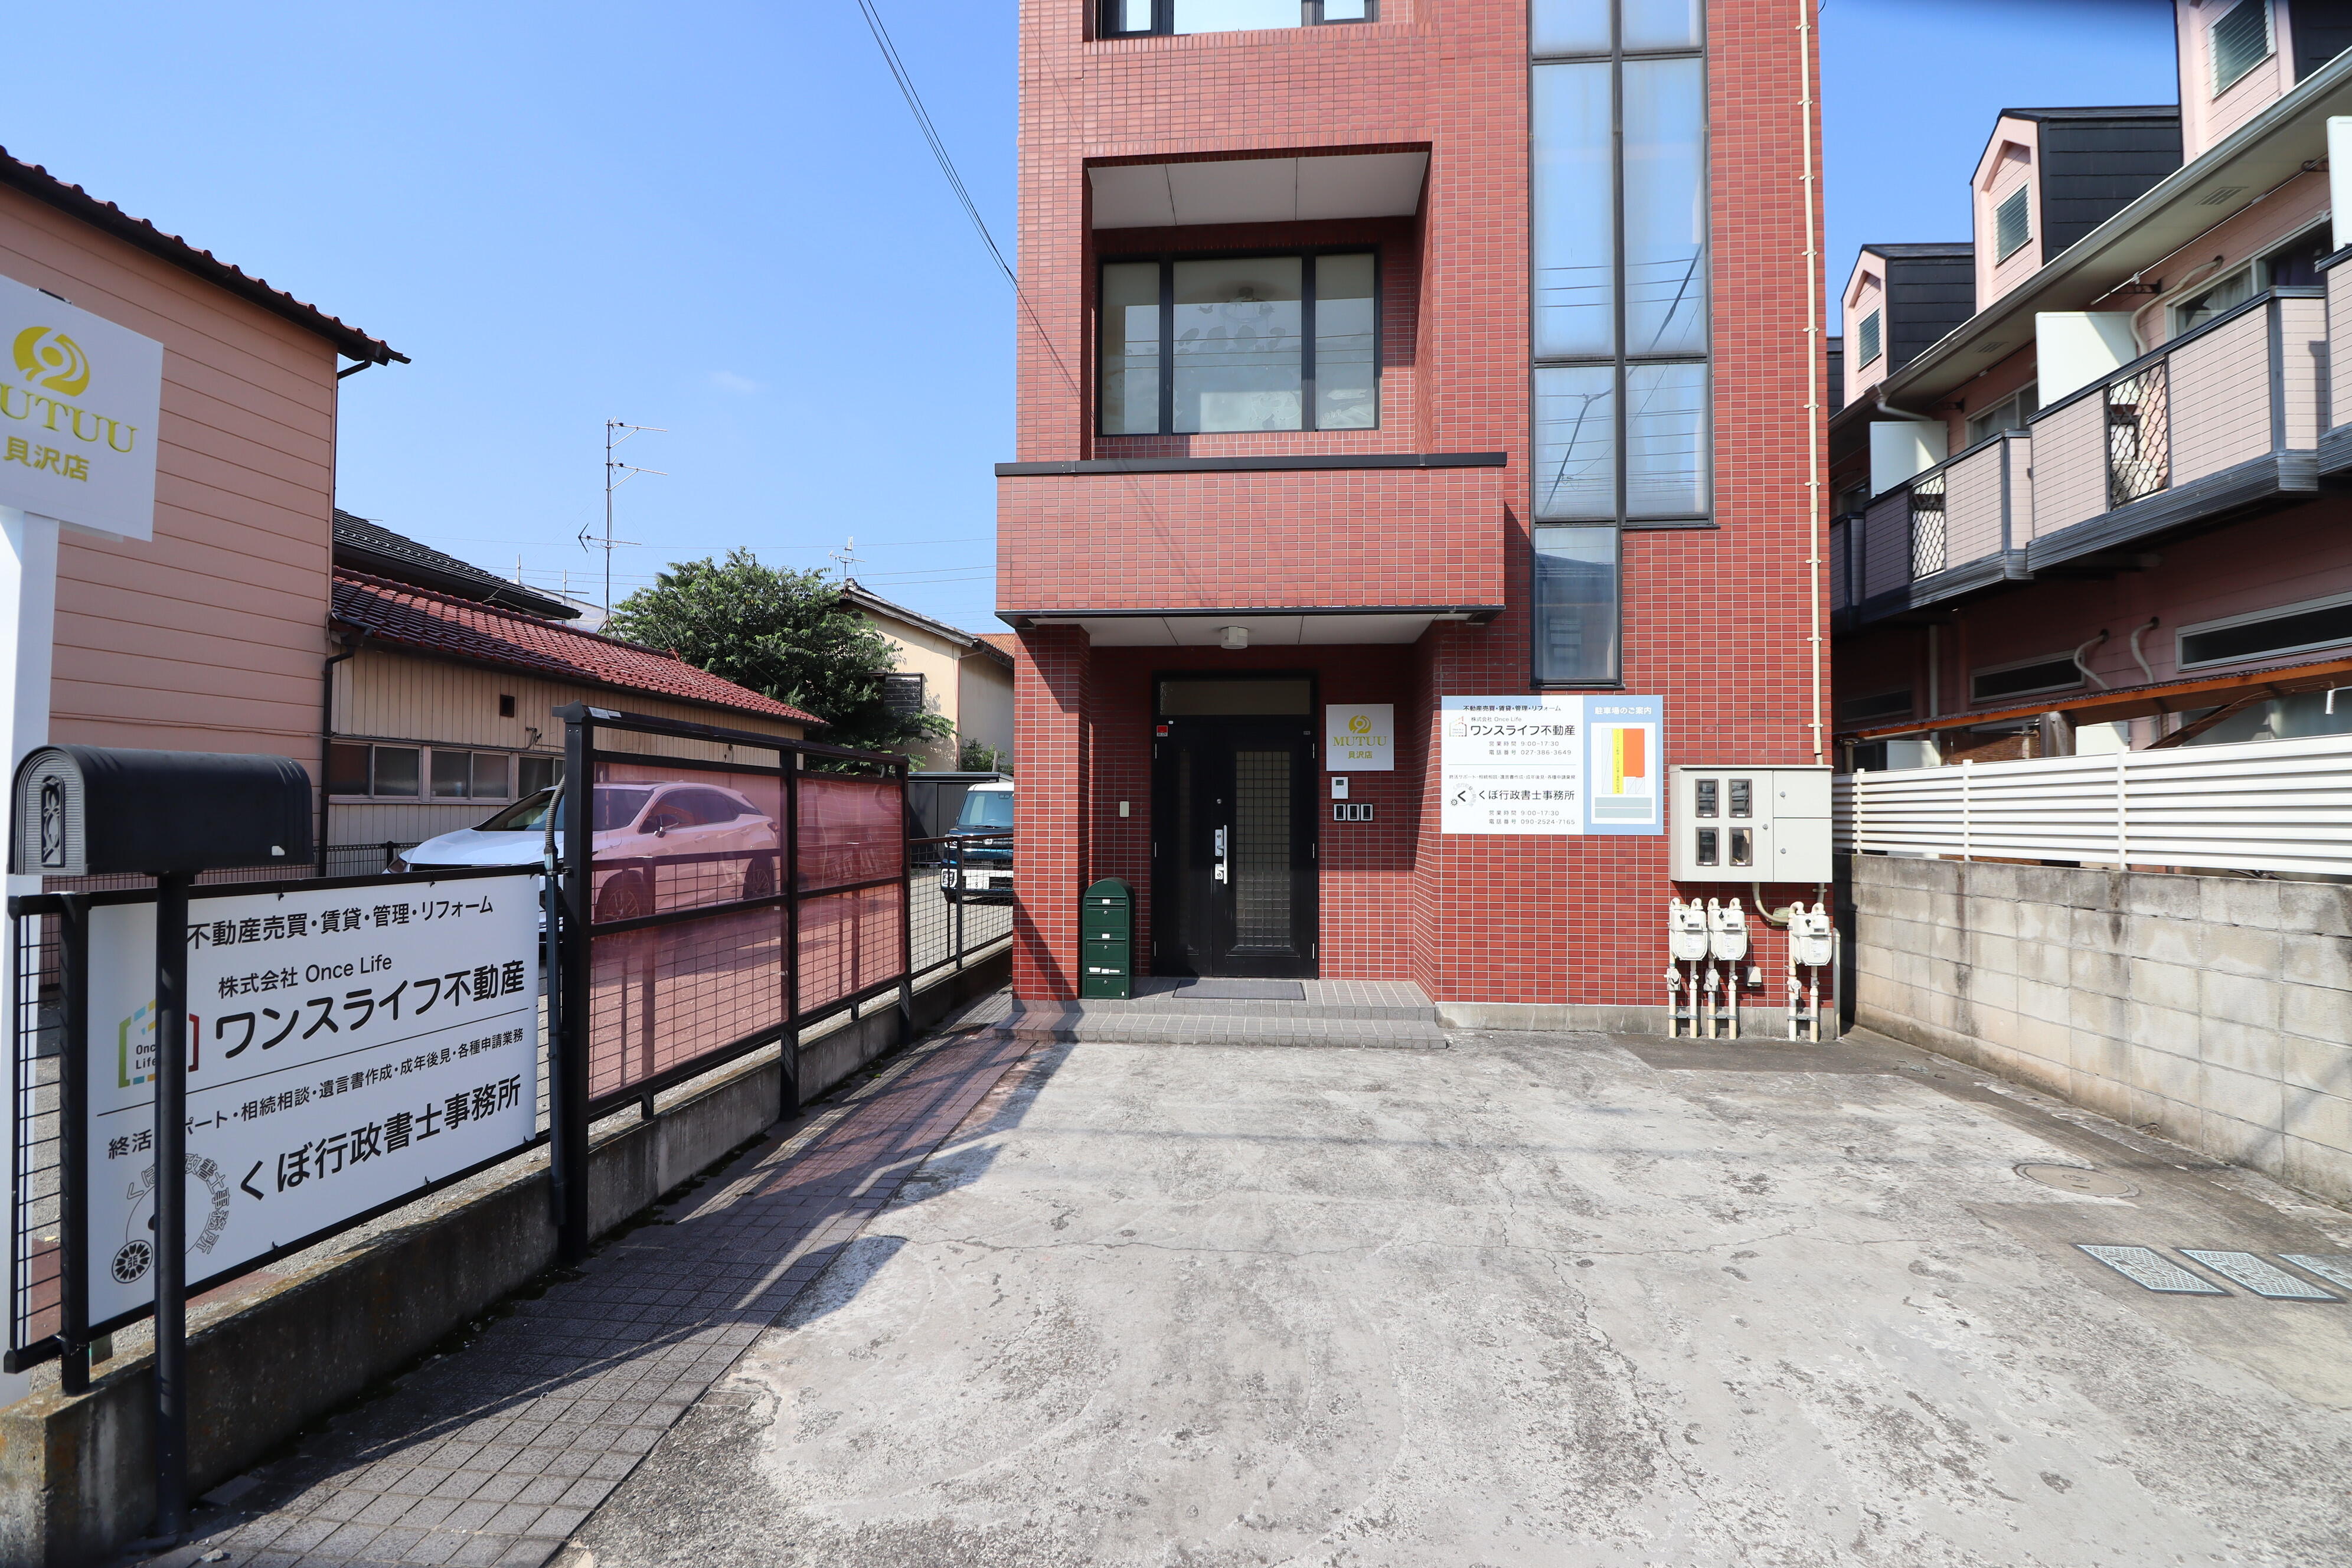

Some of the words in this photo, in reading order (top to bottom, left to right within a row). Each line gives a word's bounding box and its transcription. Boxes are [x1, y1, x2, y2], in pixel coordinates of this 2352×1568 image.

[3, 436, 90, 482] 貝沢店
[1332, 736, 1387, 746] MUTUU
[1471, 725, 1576, 736] ワンスライフ不動産
[1348, 751, 1373, 759] 貝沢店
[1479, 790, 1575, 801] くぼ行政書士事務所
[187, 896, 493, 949] 不動産売買・賃貸・管理・リフォーム
[218, 966, 298, 999] 株式会社
[305, 963, 354, 982] Once
[361, 954, 392, 974] Life
[216, 960, 525, 1059] ワンスライフ不動産
[136, 1044, 156, 1054] Onc
[108, 1028, 524, 1159] 終活ート・相続相談・遺言書作成・成年後見・各種申請業務
[240, 1074, 521, 1201] くぼ行政書士事務所
